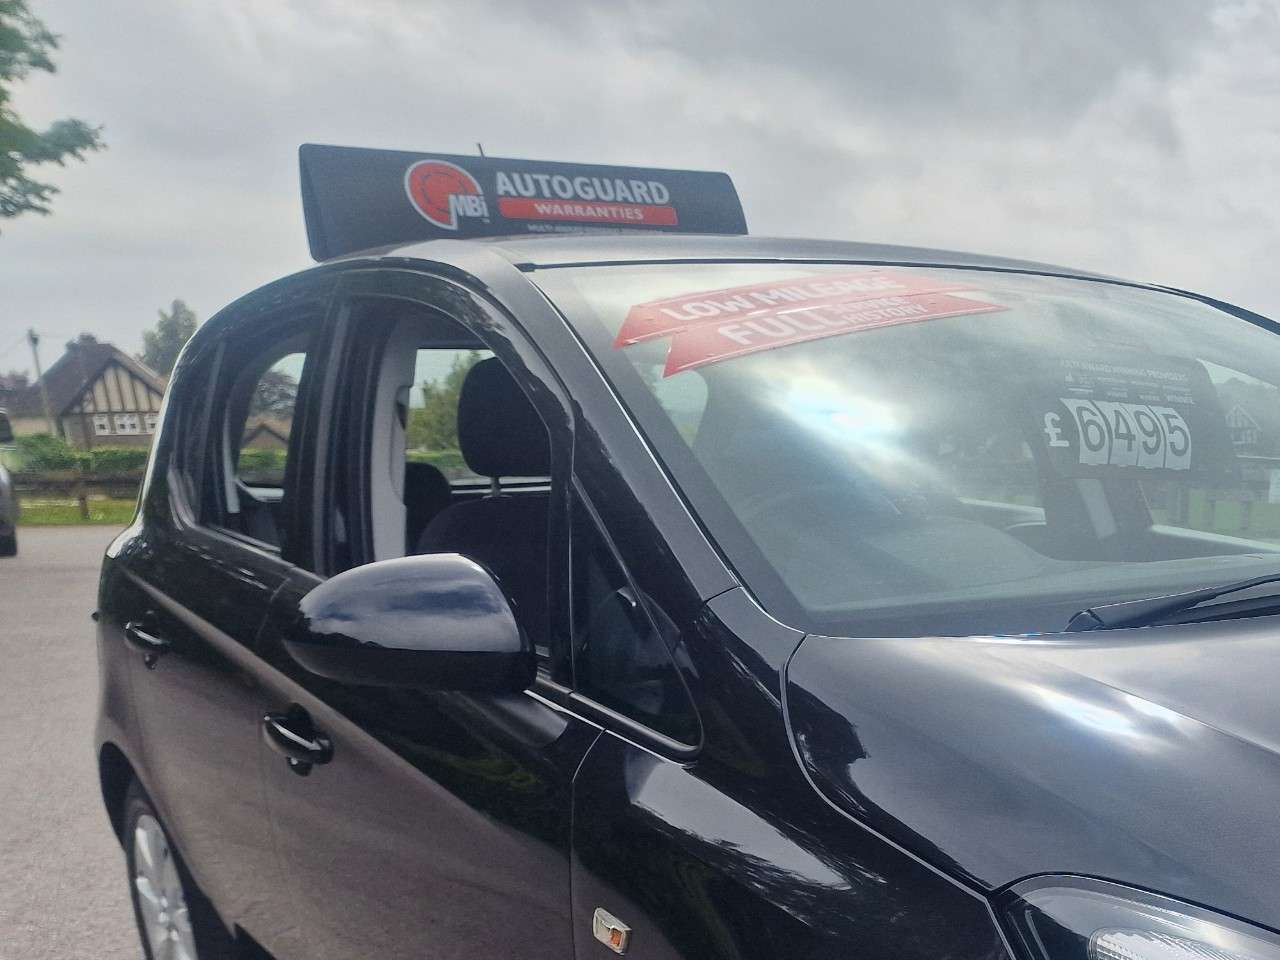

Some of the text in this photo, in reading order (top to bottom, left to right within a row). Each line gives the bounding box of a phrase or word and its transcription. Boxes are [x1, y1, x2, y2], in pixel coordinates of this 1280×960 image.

[496, 172, 670, 205] AUTOGUARD
[534, 203, 644, 220] WARRANTIES
[660, 294, 755, 321] LOW
[717, 306, 851, 346] FULL
